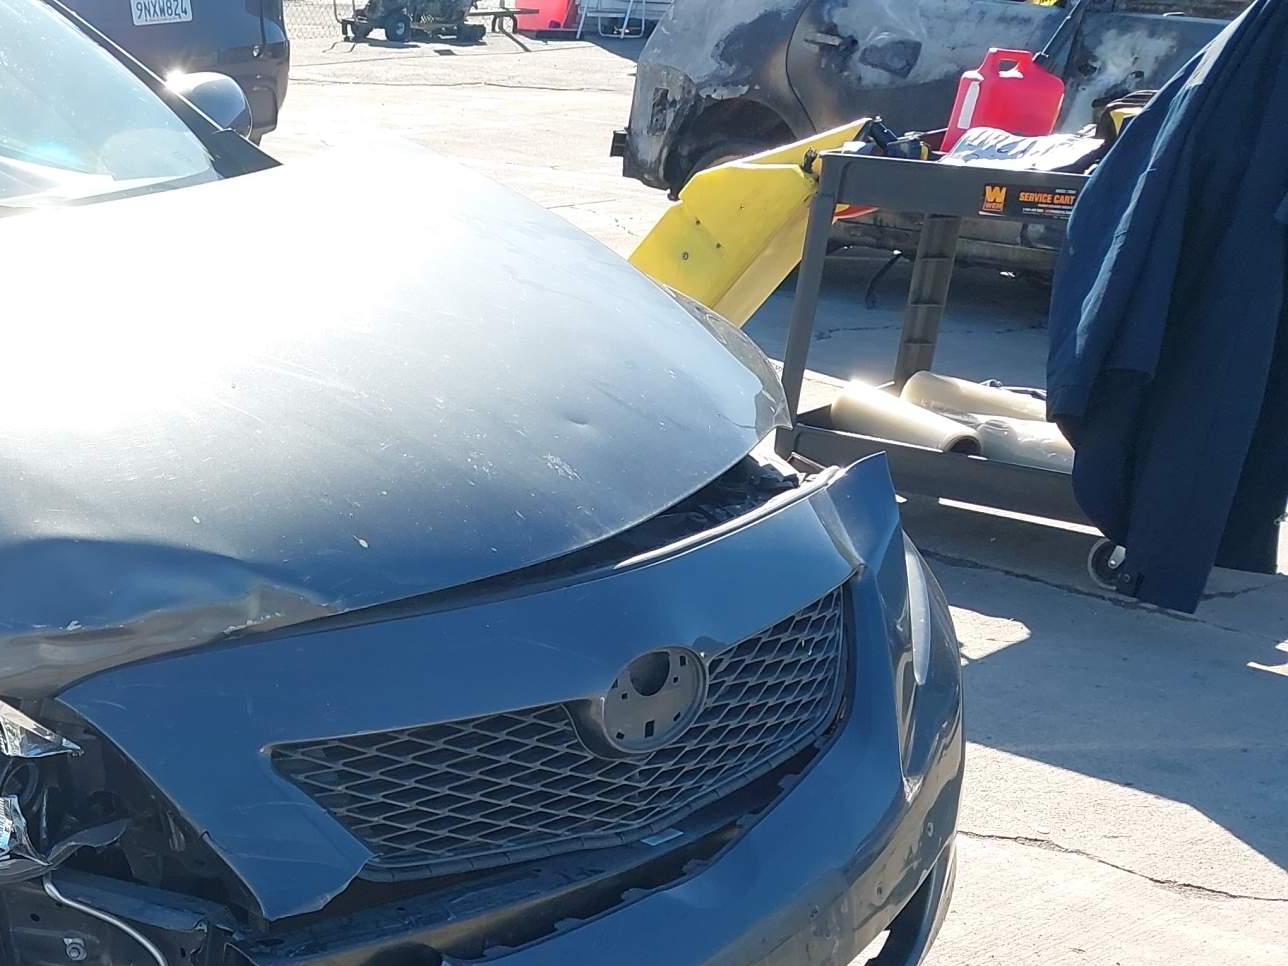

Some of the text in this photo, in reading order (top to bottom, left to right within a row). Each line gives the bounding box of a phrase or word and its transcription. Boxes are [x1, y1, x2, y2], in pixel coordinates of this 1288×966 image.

[135, 0, 188, 20] 9NXW824
[1019, 192, 1076, 205] SERVICE CART
